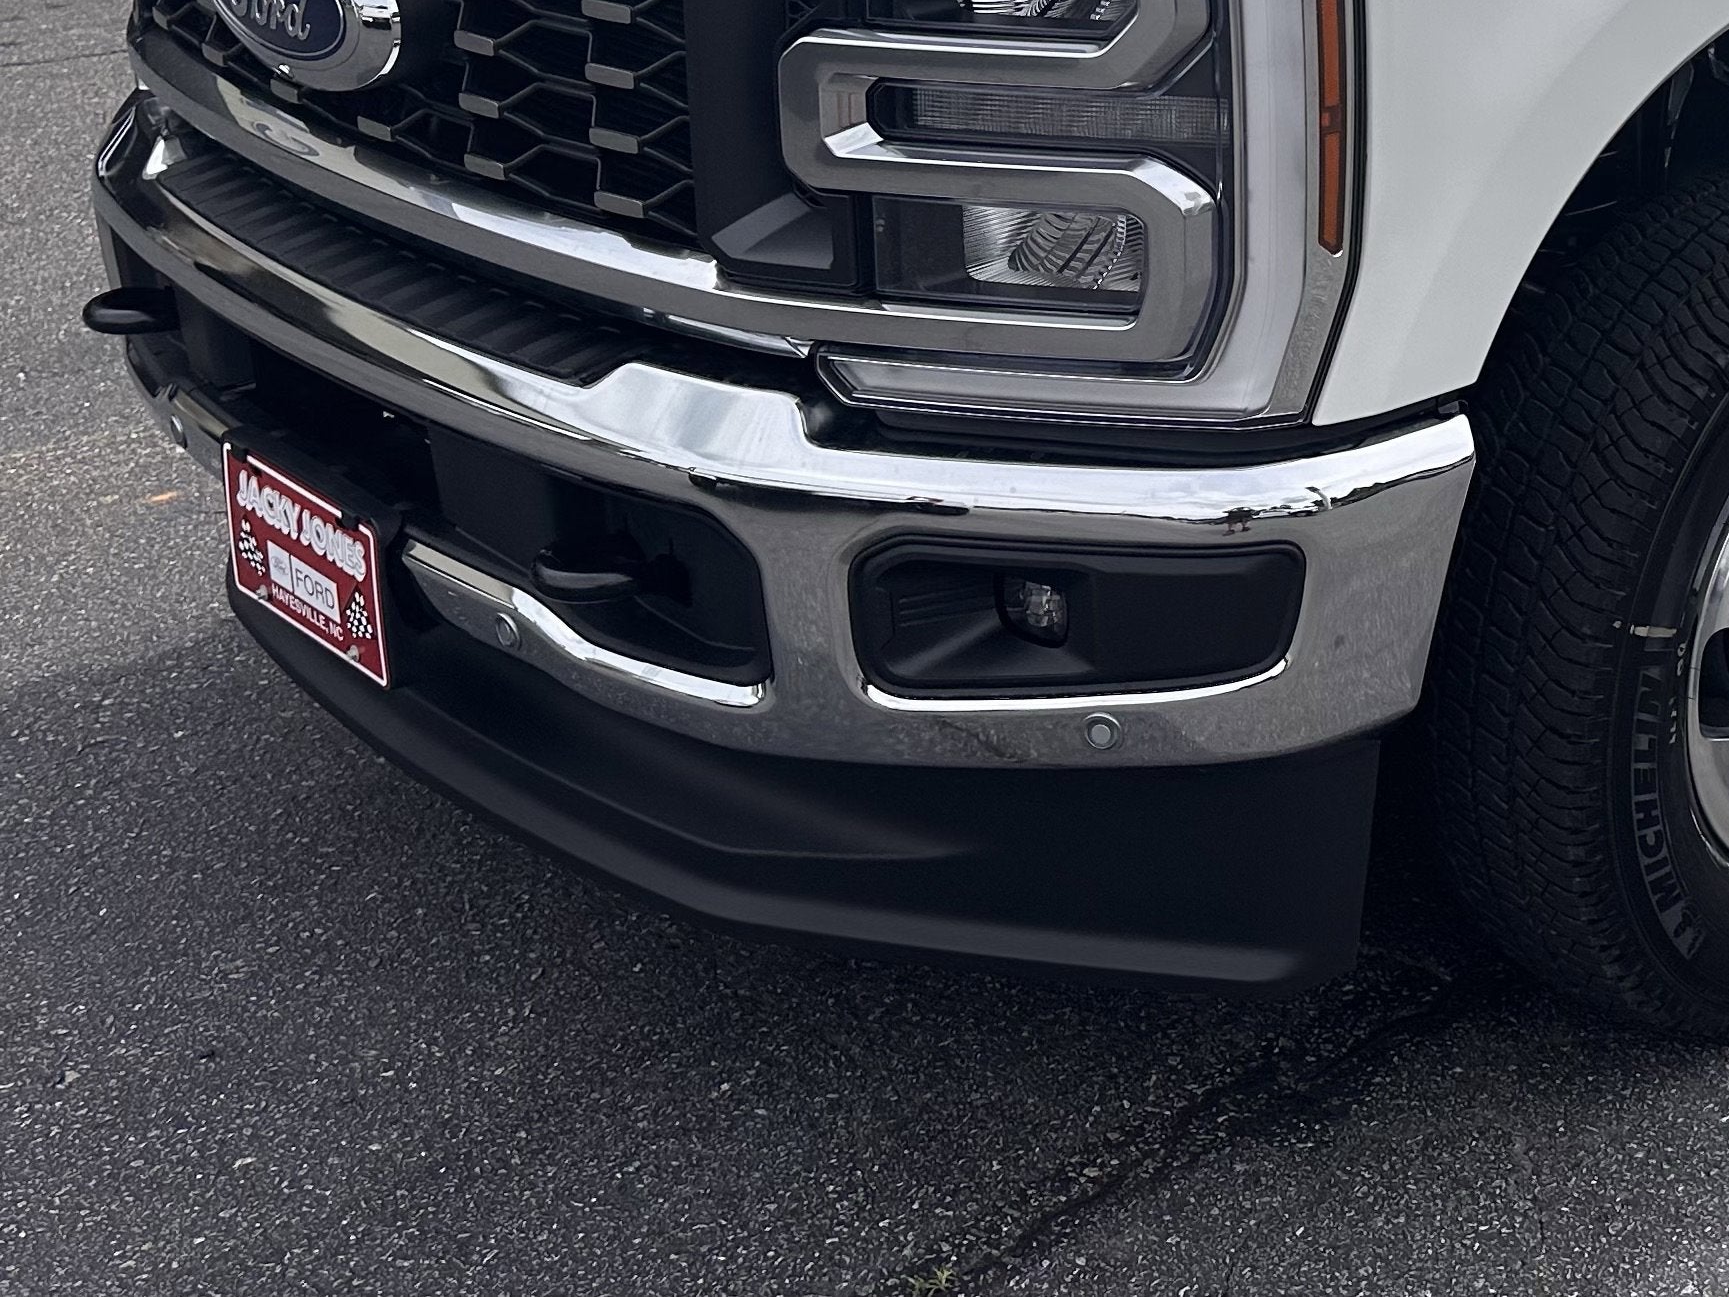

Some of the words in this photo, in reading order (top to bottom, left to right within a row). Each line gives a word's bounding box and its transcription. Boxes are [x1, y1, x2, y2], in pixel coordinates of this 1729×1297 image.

[236, 469, 302, 540] JACKY
[299, 508, 367, 582] JONES
[295, 568, 335, 610] FORD
[329, 621, 344, 642] NC
[1631, 667, 1687, 911] MICHELIN
